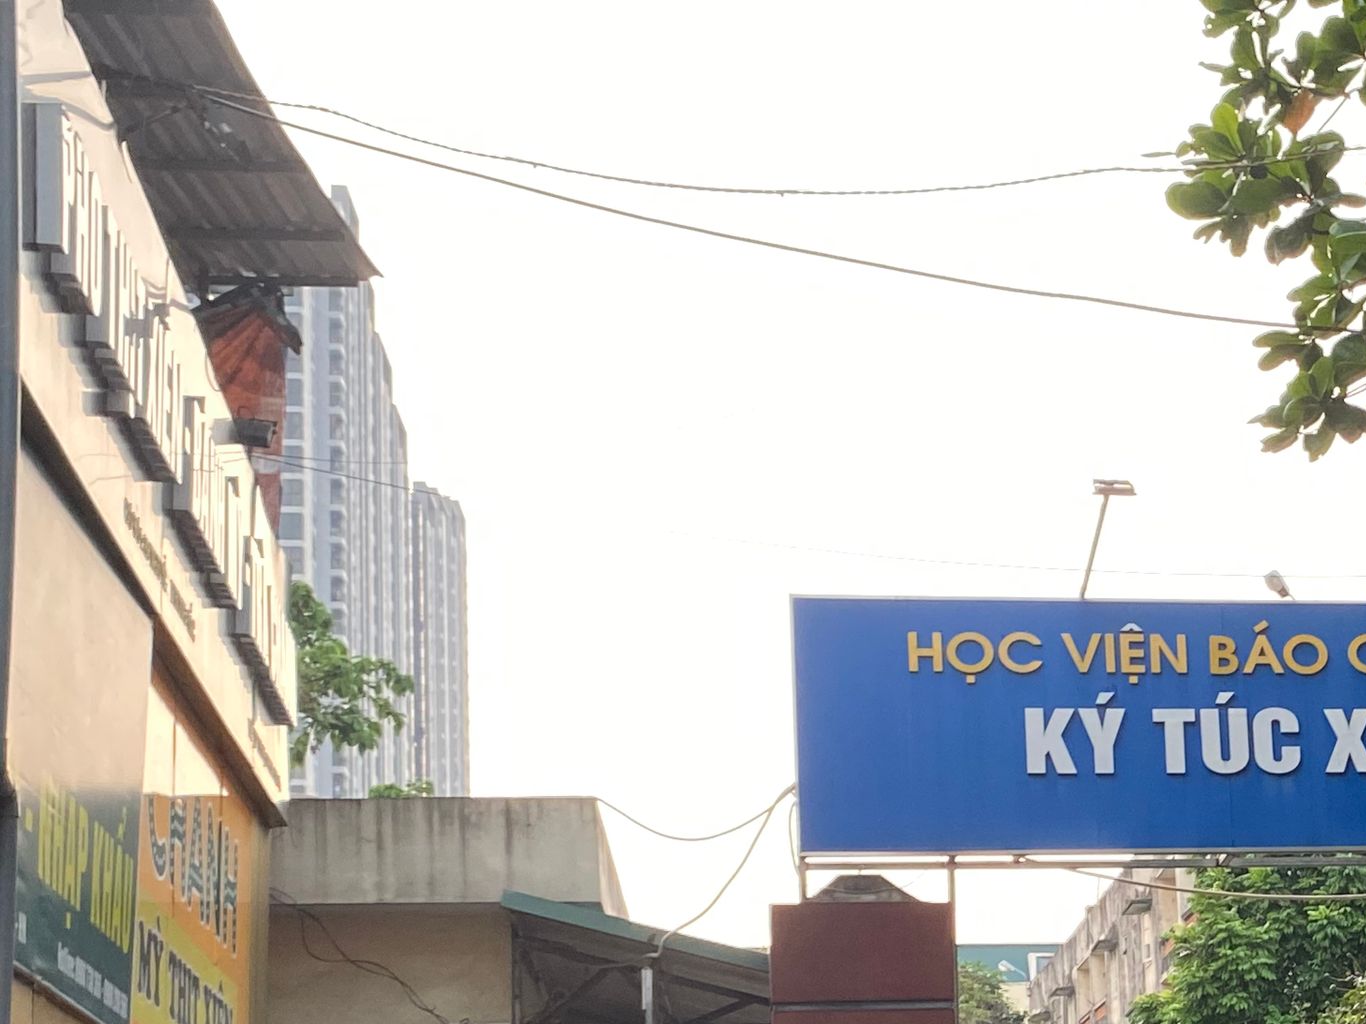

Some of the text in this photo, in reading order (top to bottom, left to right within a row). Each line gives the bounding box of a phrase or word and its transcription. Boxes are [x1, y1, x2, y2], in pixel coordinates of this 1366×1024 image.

[907, 631, 1044, 685] HỌC
[1060, 622, 1189, 685] VIỆN
[1208, 619, 1329, 676] BÁO
[1024, 691, 1127, 775] KÝ
[1152, 691, 1302, 775] TÚC
